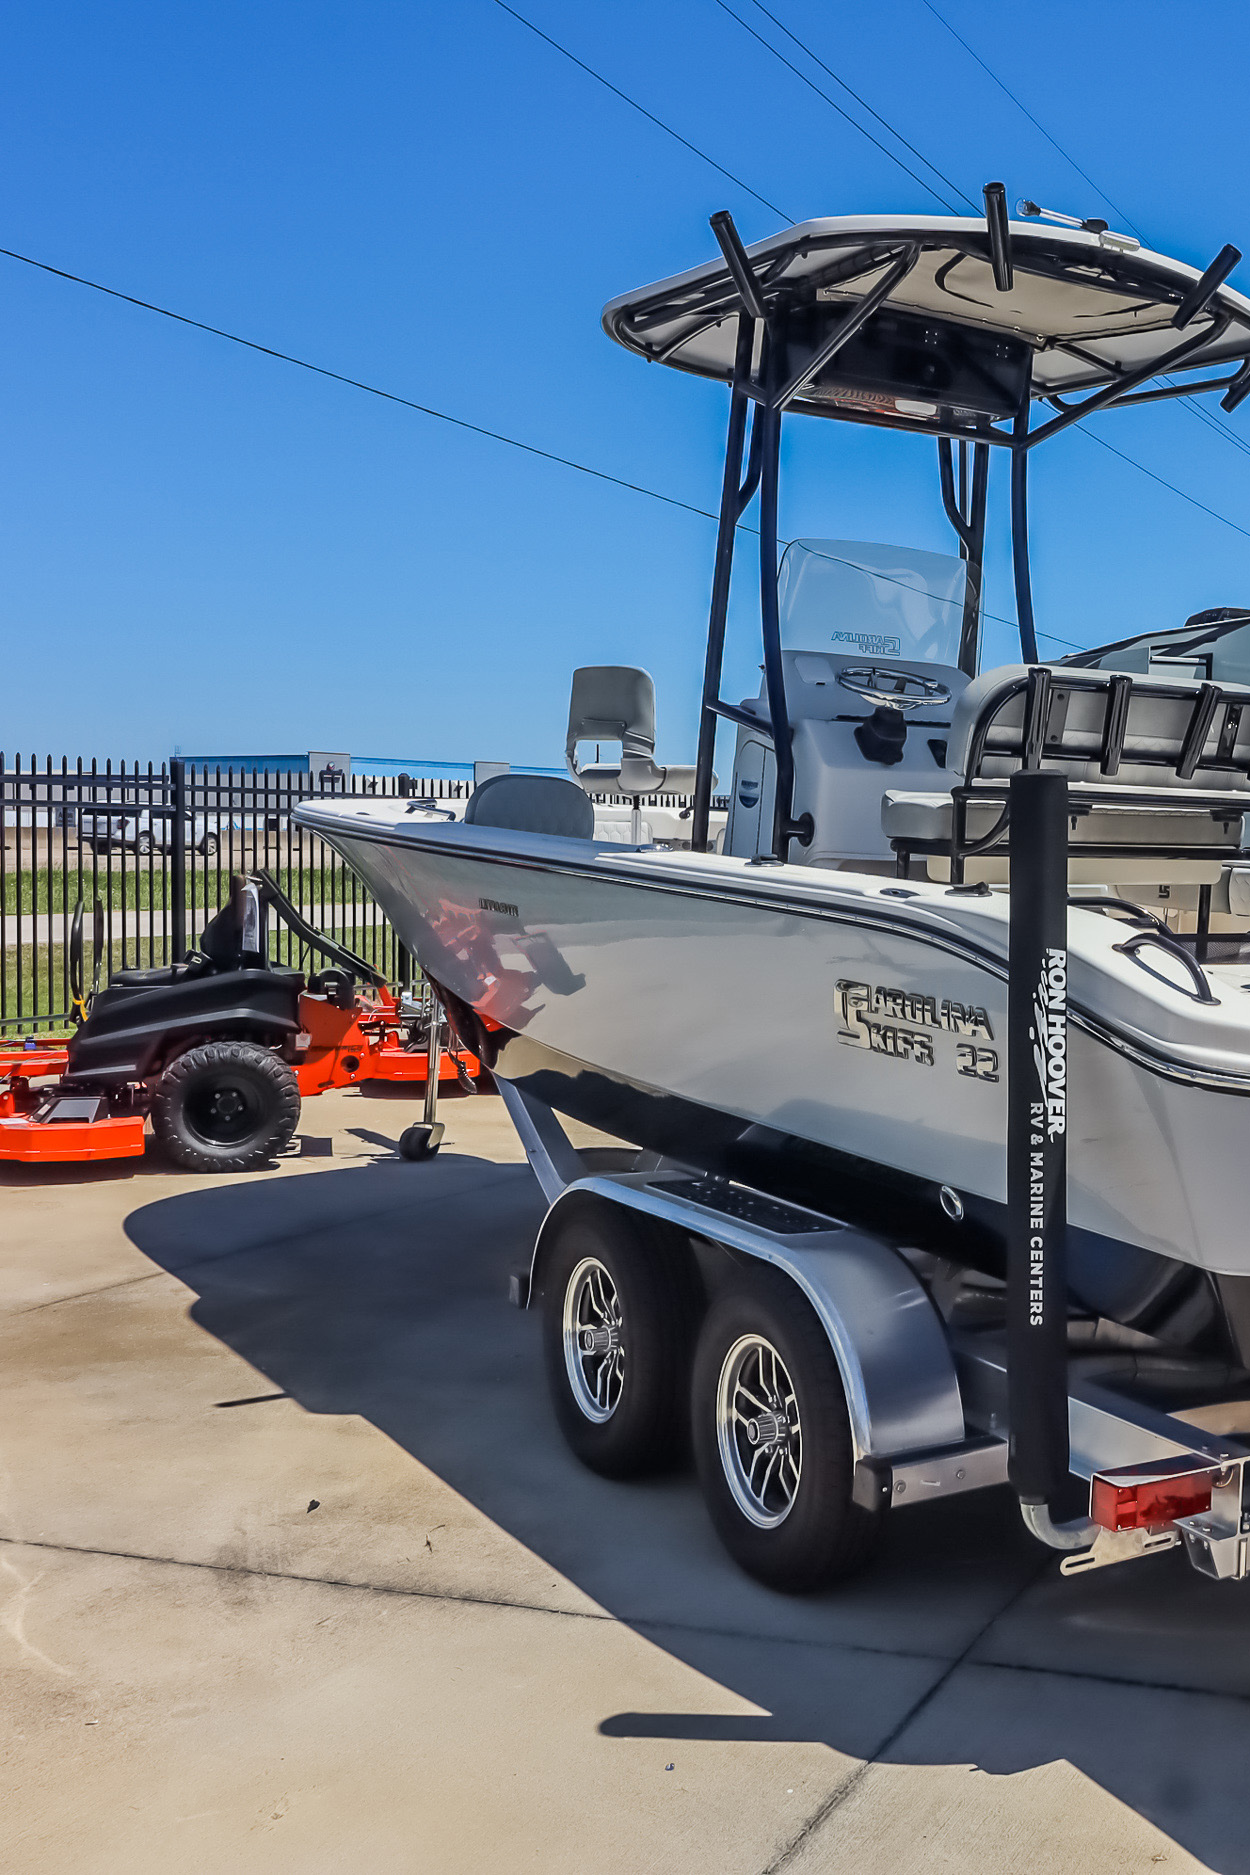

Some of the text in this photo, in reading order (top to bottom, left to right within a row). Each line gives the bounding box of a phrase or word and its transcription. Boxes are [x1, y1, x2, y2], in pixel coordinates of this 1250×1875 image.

[833, 978, 995, 1041] CAROLINA
[955, 1042, 1000, 1083] 22
[1047, 948, 1067, 1138] RON HOOVER
[1029, 1102, 1044, 1326] RV & MARINE CENTERS
